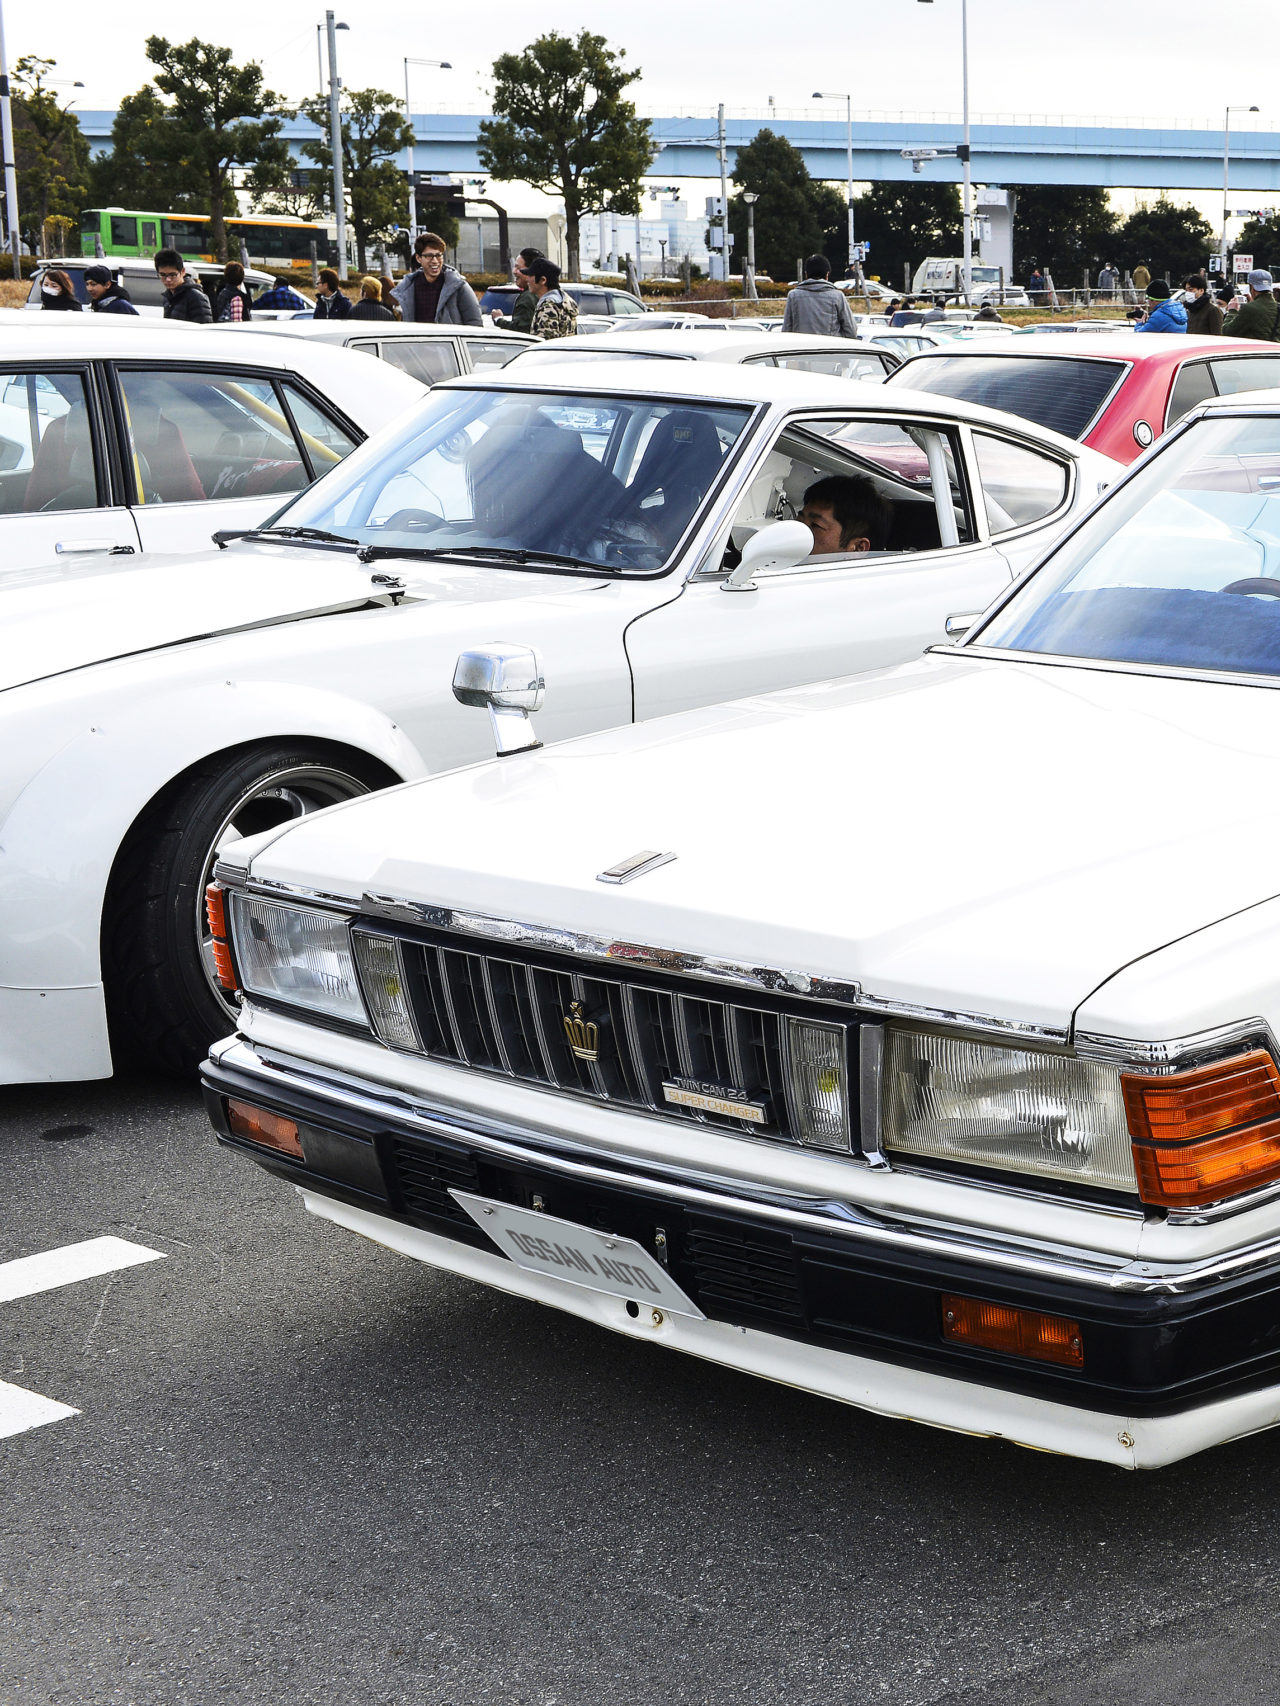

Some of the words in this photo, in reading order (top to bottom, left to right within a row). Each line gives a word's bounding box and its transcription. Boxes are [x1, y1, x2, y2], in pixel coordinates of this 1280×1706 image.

[676, 1078, 701, 1092] TWIN
[702, 1083, 726, 1098] CAM
[668, 1090, 706, 1109] SUPER
[706, 1100, 761, 1120] CHARGER
[505, 1229, 597, 1276] OSSAN
[591, 1253, 662, 1294] AUTO
